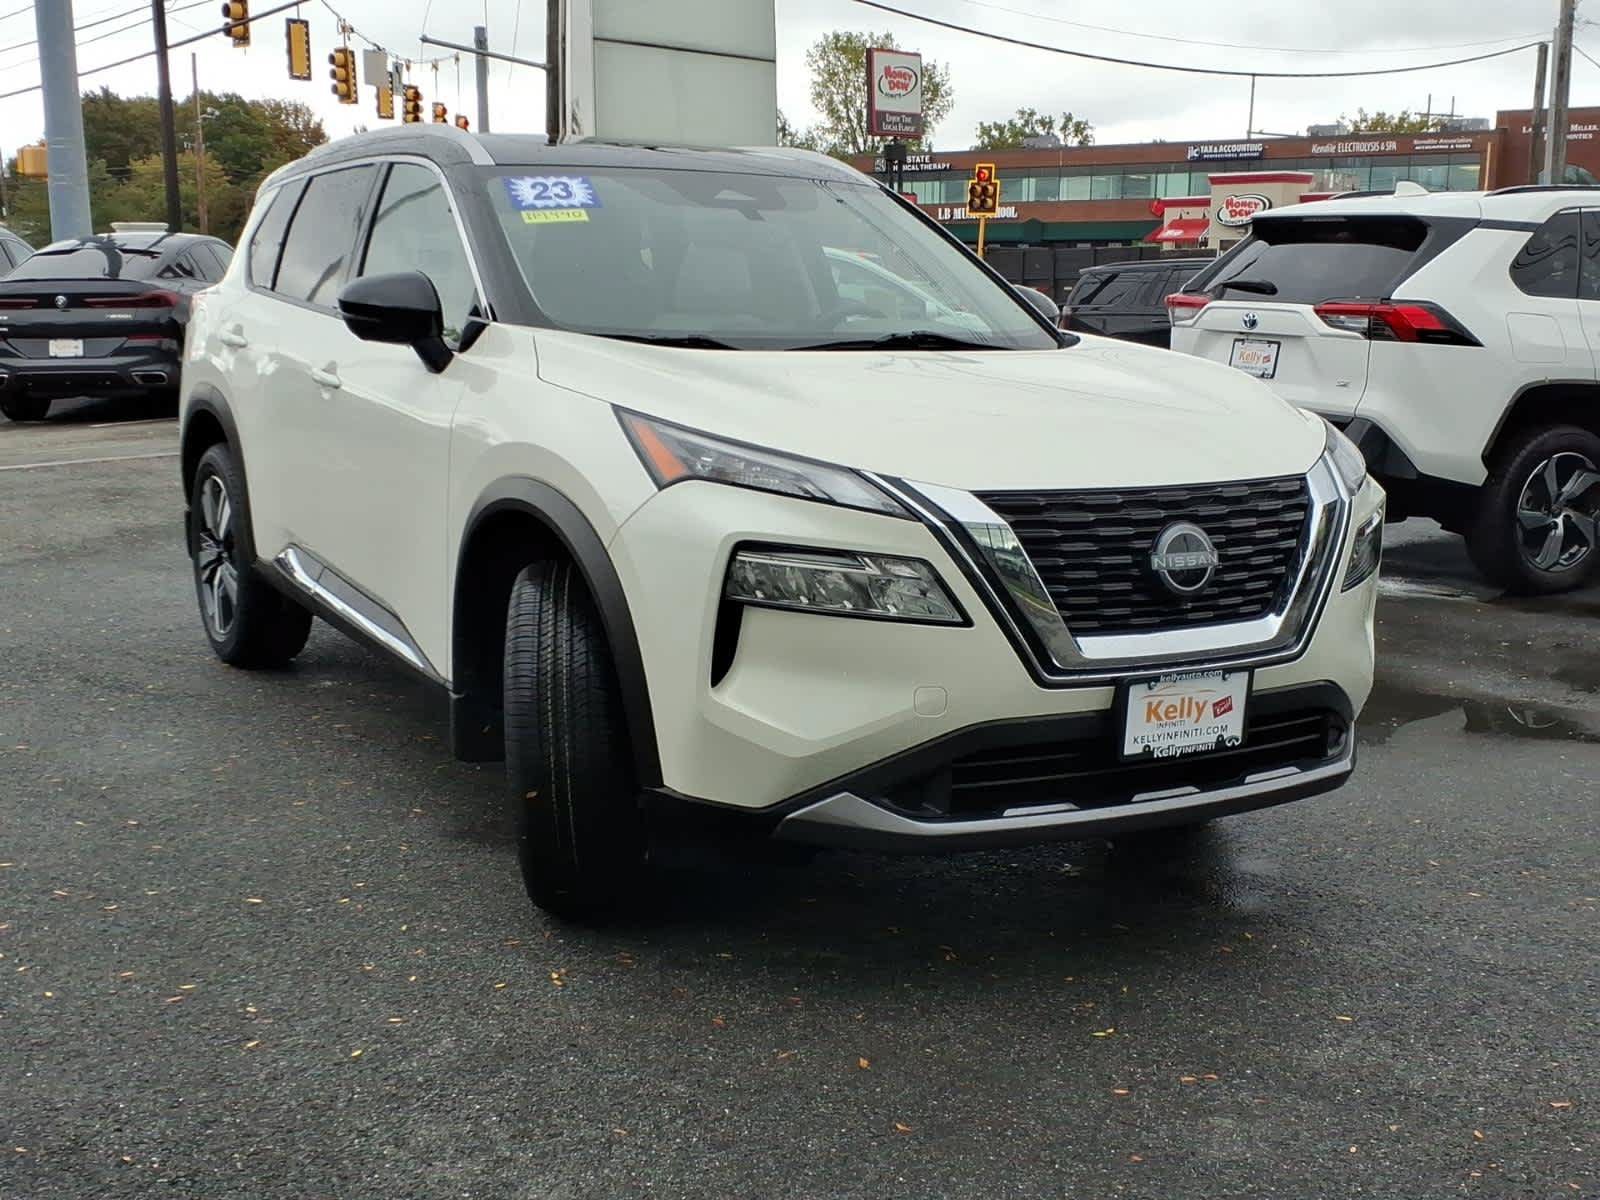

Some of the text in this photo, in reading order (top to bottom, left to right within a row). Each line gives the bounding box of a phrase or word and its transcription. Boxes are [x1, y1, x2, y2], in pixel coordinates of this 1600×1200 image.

[1218, 143, 1263, 153] ACCOUNTING
[1338, 142, 1380, 152] ELECTROLYSIS
[1386, 141, 1397, 151] SPA
[906, 155, 930, 163] STATE
[920, 162, 950, 170] THERAPY
[530, 181, 573, 200] 23
[1225, 197, 1260, 210] HONEY
[1153, 554, 1217, 569] NISSAN
[1145, 697, 1208, 723] Kelly
[1156, 720, 1185, 729] INFINITI
[1132, 724, 1228, 745] KELLYINFINITI.COM
